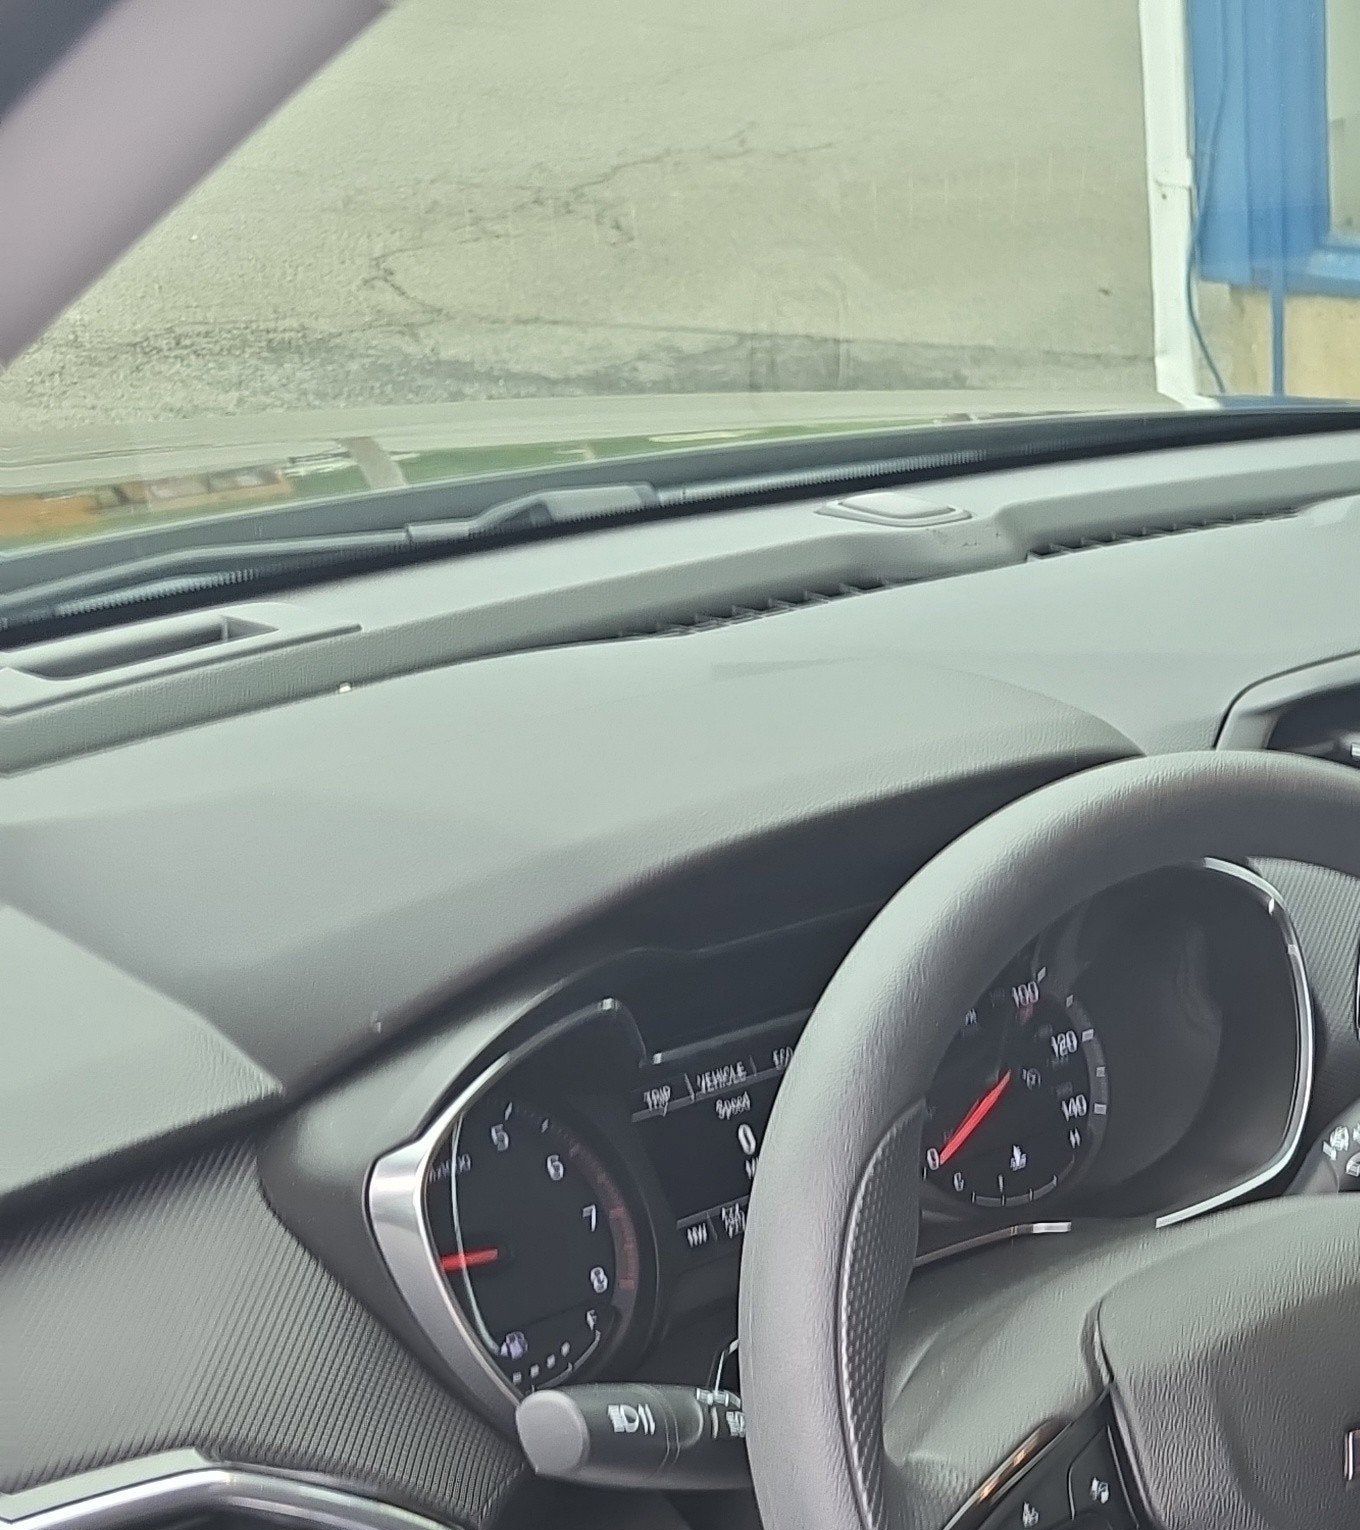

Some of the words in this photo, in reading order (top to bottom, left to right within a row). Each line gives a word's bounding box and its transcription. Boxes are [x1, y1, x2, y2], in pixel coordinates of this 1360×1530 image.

[1011, 981, 1039, 1008] 100
[1051, 1029, 1078, 1058] 120
[697, 1061, 748, 1094] VEHICLE
[1061, 1093, 1088, 1122] 140
[490, 1124, 509, 1151] 5
[738, 1123, 757, 1155] 0
[547, 1154, 564, 1181] 6
[582, 1204, 597, 1232] 7
[590, 1266, 608, 1293] 8
